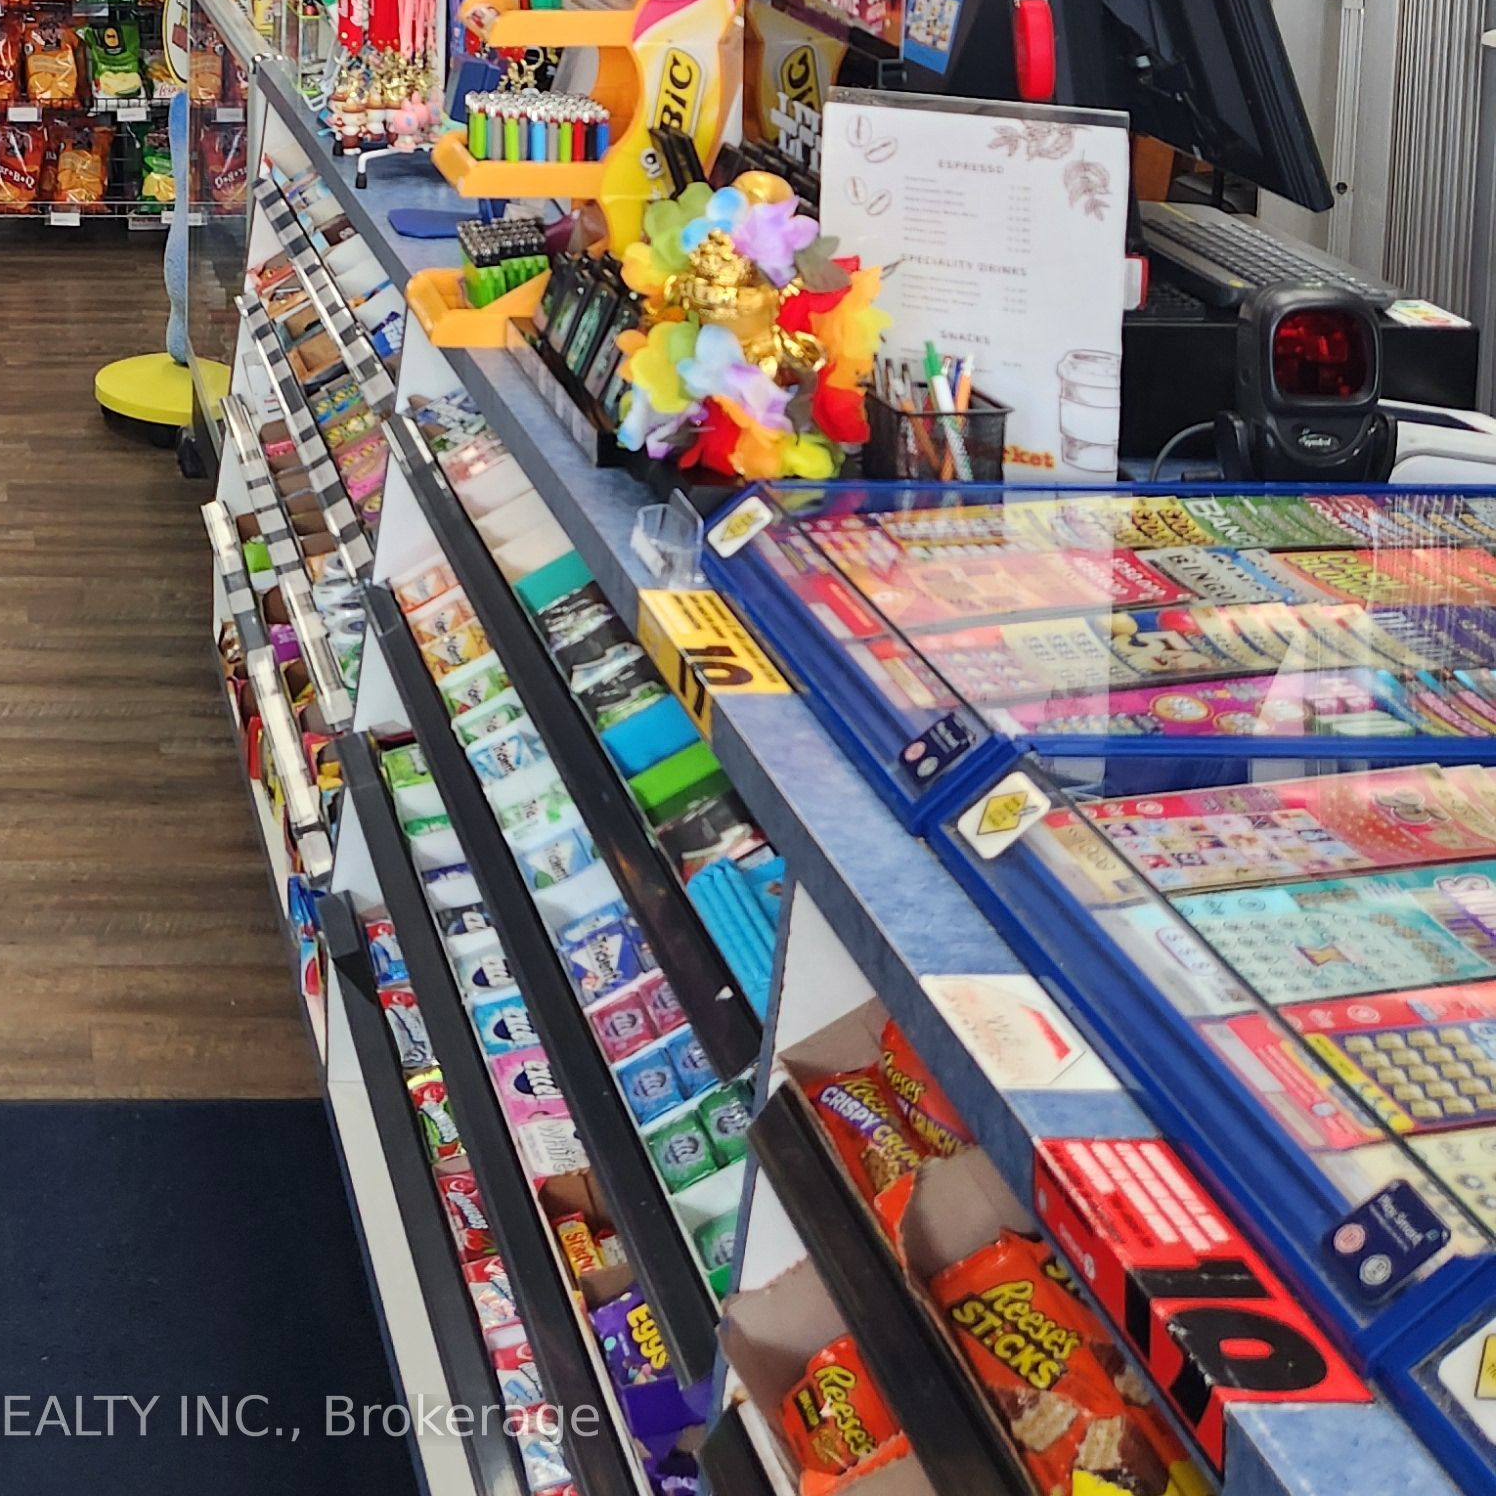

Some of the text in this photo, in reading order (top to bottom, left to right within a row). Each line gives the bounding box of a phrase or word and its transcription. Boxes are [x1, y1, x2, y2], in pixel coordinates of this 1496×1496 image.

[939, 160, 1005, 174] ESPRESSO
[979, 262, 1028, 277] DRINKS
[941, 330, 991, 345] SNACKS
[1168, 554, 1238, 600] BINGO
[820, 1086, 882, 1131] CRISPY
[981, 1280, 1081, 1360] Reese's
[953, 1299, 1062, 1391] STICKS
